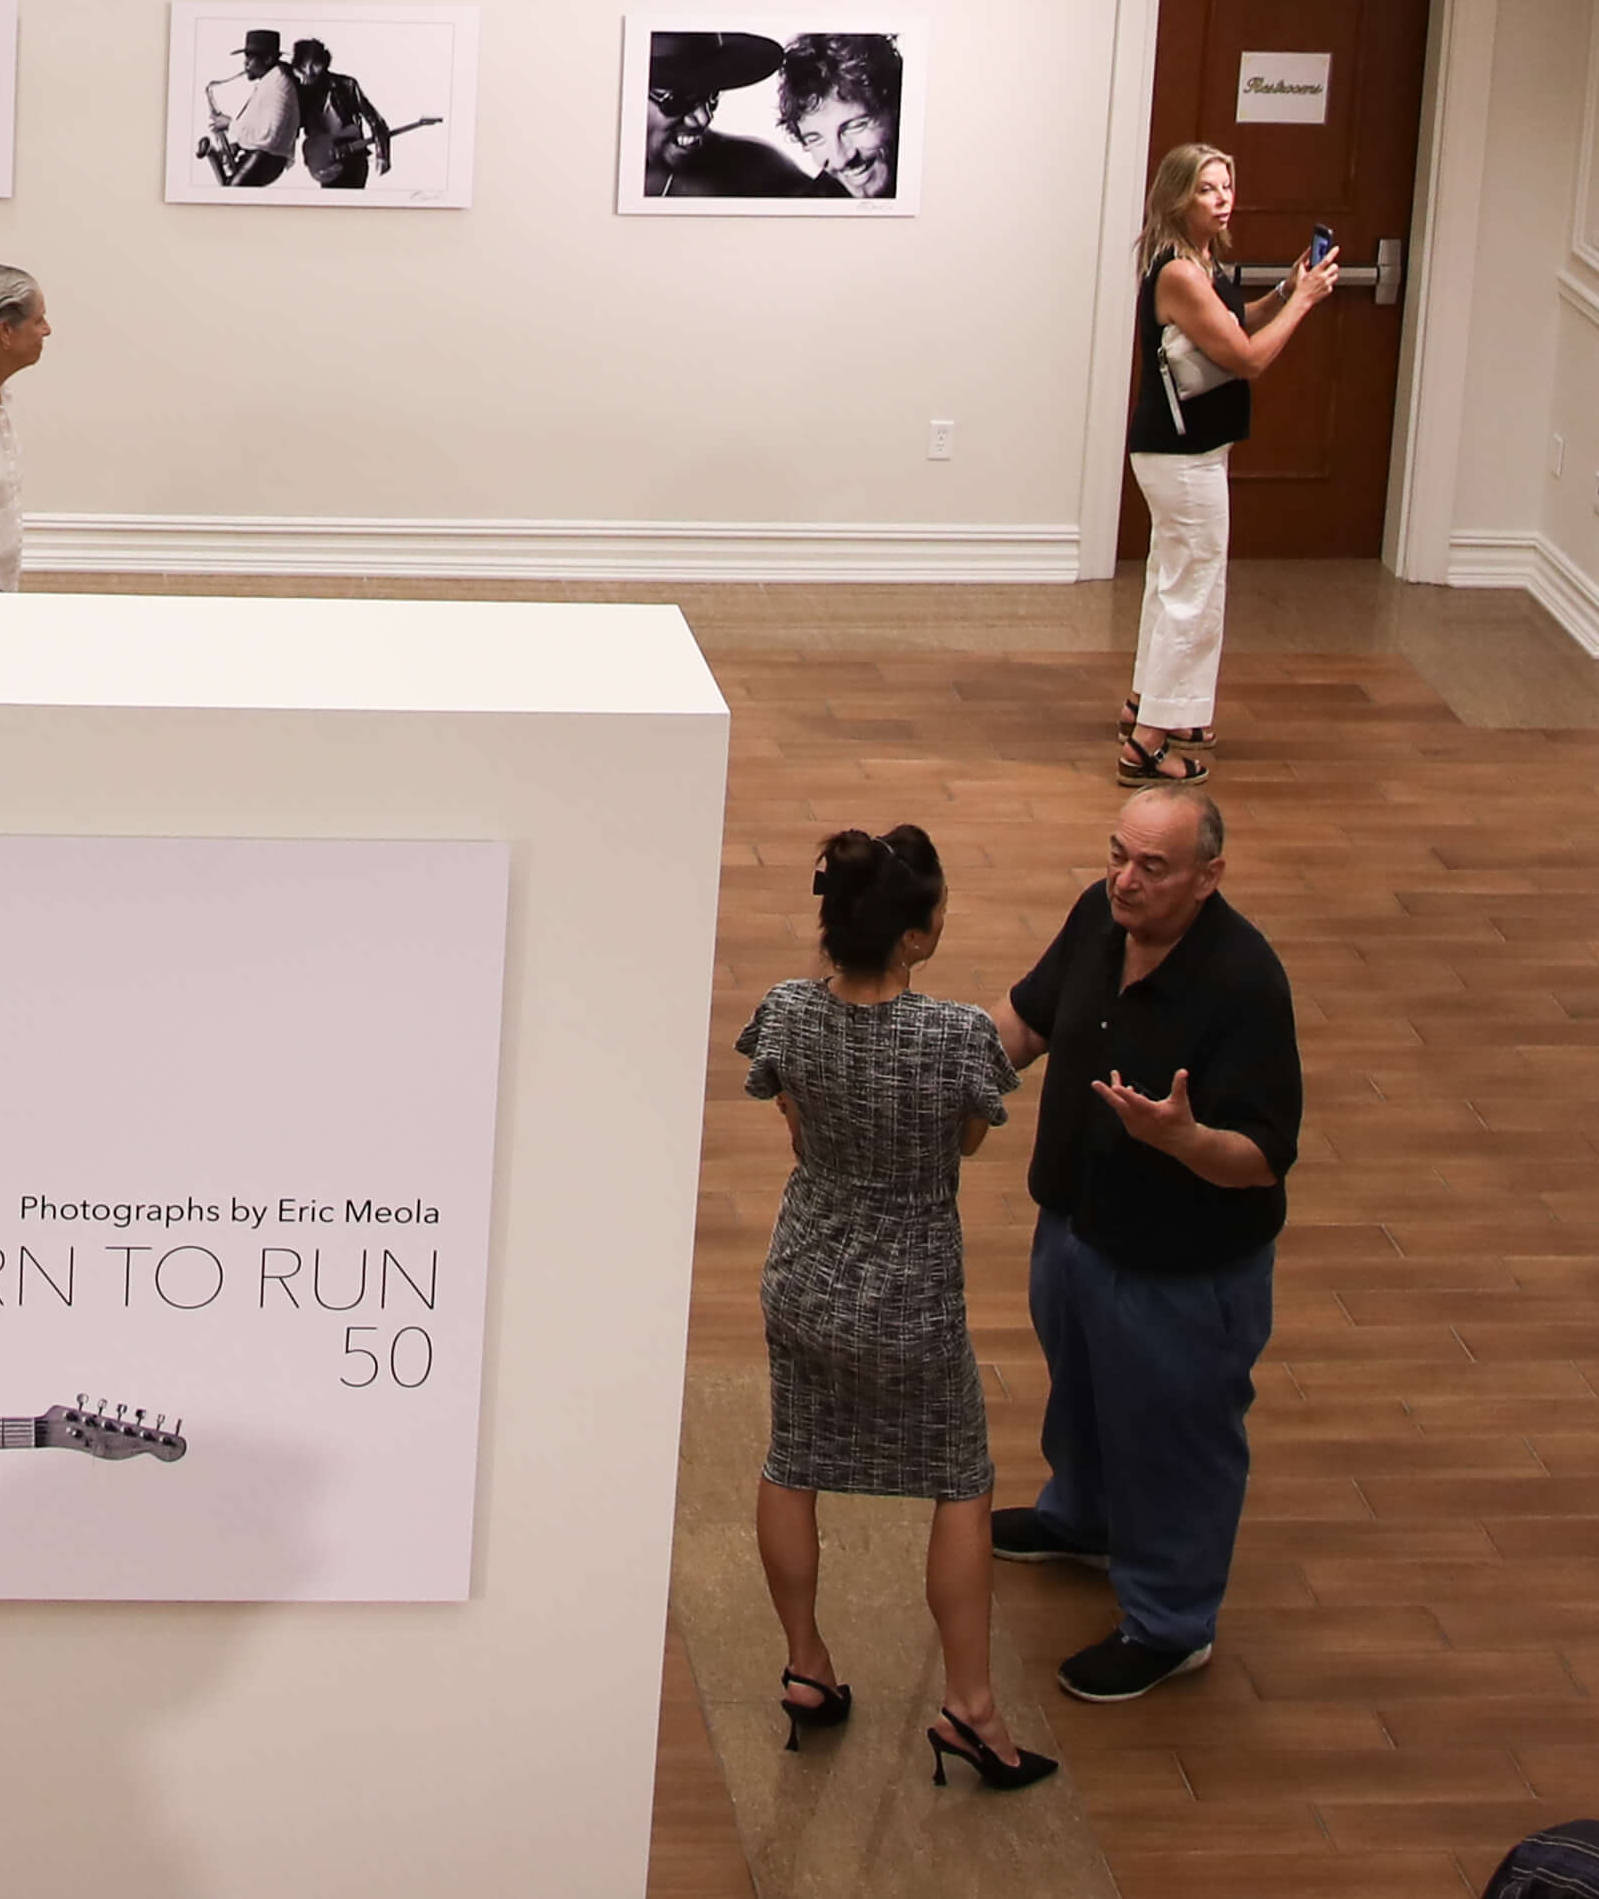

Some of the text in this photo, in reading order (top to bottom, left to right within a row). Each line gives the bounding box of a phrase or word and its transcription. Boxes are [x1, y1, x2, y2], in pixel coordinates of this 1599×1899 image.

[1243, 77, 1322, 94] Restrooms
[20, 1193, 440, 1230] Photographs by Eric Meola
[106, 1246, 224, 1311] TO
[259, 1247, 438, 1312] RUN
[339, 1325, 433, 1389] 50
